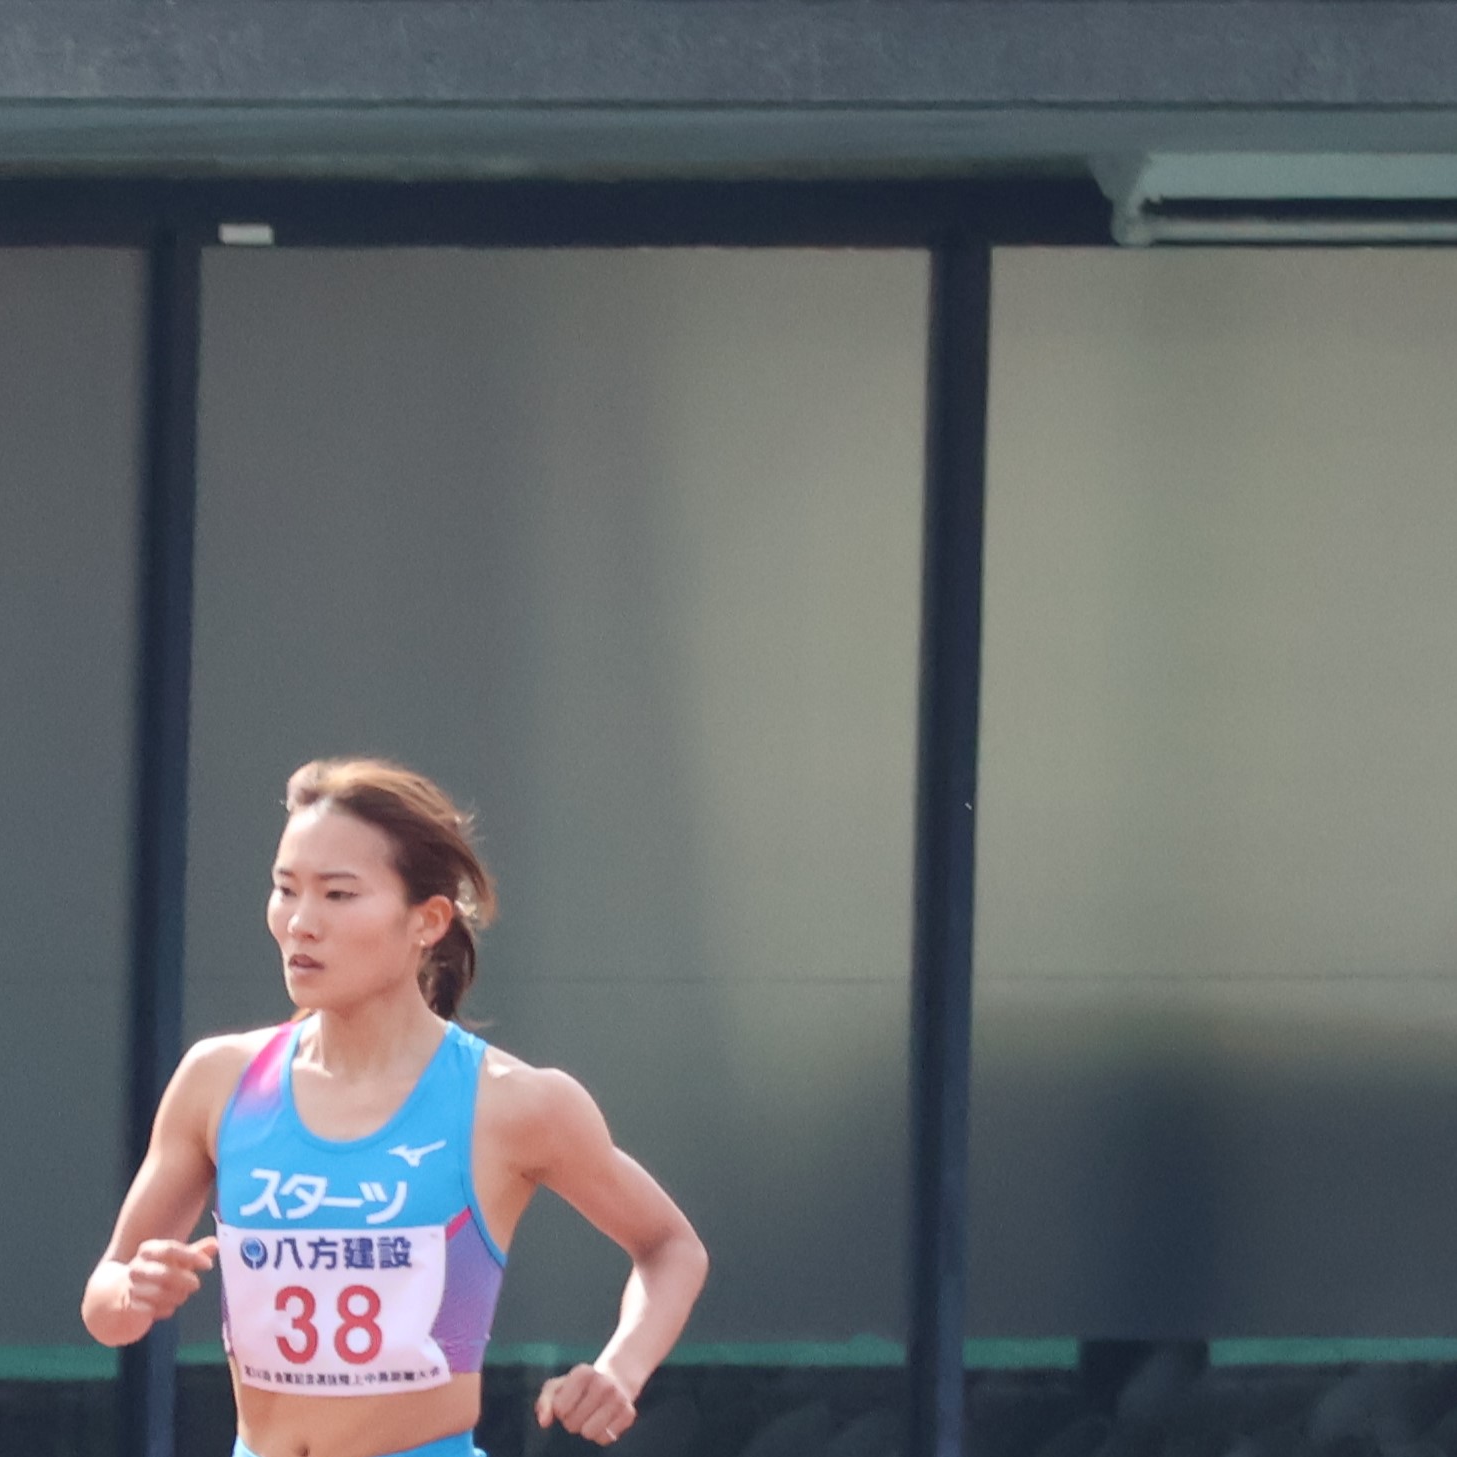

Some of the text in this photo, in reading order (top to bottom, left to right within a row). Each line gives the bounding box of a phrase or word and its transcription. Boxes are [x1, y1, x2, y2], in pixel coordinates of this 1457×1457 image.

[239, 1168, 408, 1224] スターツ
[273, 1236, 413, 1270] 八方建設
[274, 1284, 383, 1365] 38
